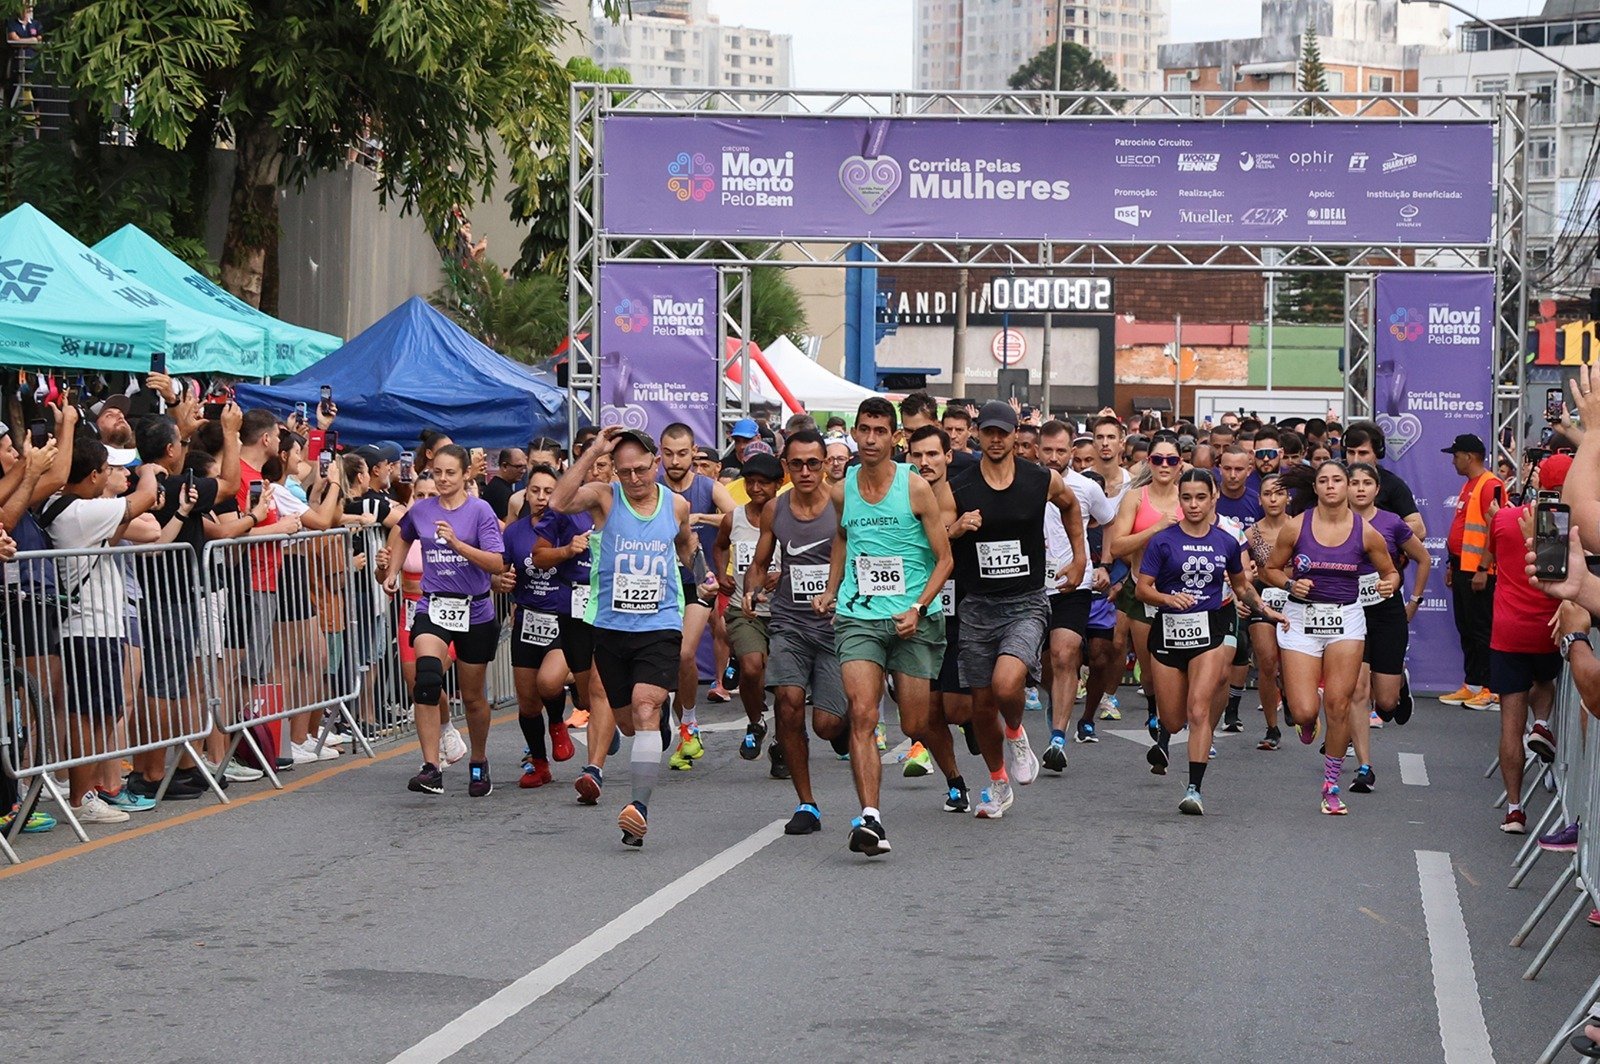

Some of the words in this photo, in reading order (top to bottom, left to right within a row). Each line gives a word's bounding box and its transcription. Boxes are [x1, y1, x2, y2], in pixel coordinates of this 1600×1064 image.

[1114, 138, 1156, 147] Patrocínio
[1158, 138, 1193, 147] Circuito:
[1182, 153, 1216, 162] WORLD
[1289, 150, 1334, 166] ophir
[1349, 155, 1369, 168] FT
[1382, 158, 1405, 172] SHARK
[1404, 153, 1418, 165] PRO
[721, 151, 794, 177] Movi
[908, 158, 971, 172] Corrida
[975, 159, 1022, 173] Pelas
[1177, 162, 1218, 172] TENNIS
[721, 176, 794, 192] mento
[909, 172, 1071, 201] Mulheres
[1114, 188, 1158, 198] Promoção:
[1178, 189, 1225, 198] Realização:
[1308, 190, 1335, 198] Apoio:
[1366, 190, 1410, 199] Instituição
[1412, 190, 1463, 199] Beneficiada:
[1117, 209, 1136, 218] nsc
[1320, 207, 1346, 220] IDEAL
[653, 297, 704, 315] Movi
[653, 314, 704, 326] mento
[1428, 306, 1481, 324] Movi
[1428, 323, 1481, 335] mento
[83, 340, 134, 359] HUPI
[633, 382, 663, 390] Corrida
[664, 382, 686, 390] Pelas
[633, 389, 709, 402] Mulheres
[1407, 391, 1437, 399] Corrida
[1439, 391, 1461, 399] Pelas
[1407, 398, 1484, 411] Mulheres
[987, 554, 1020, 566] 1175
[870, 570, 900, 582] 386
[622, 589, 657, 600] 1227
[1428, 599, 1447, 607] IDEAL
[439, 609, 466, 620] 337
[1311, 616, 1343, 626] 1130
[529, 624, 557, 636] 1174
[1171, 627, 1202, 638] 1030
